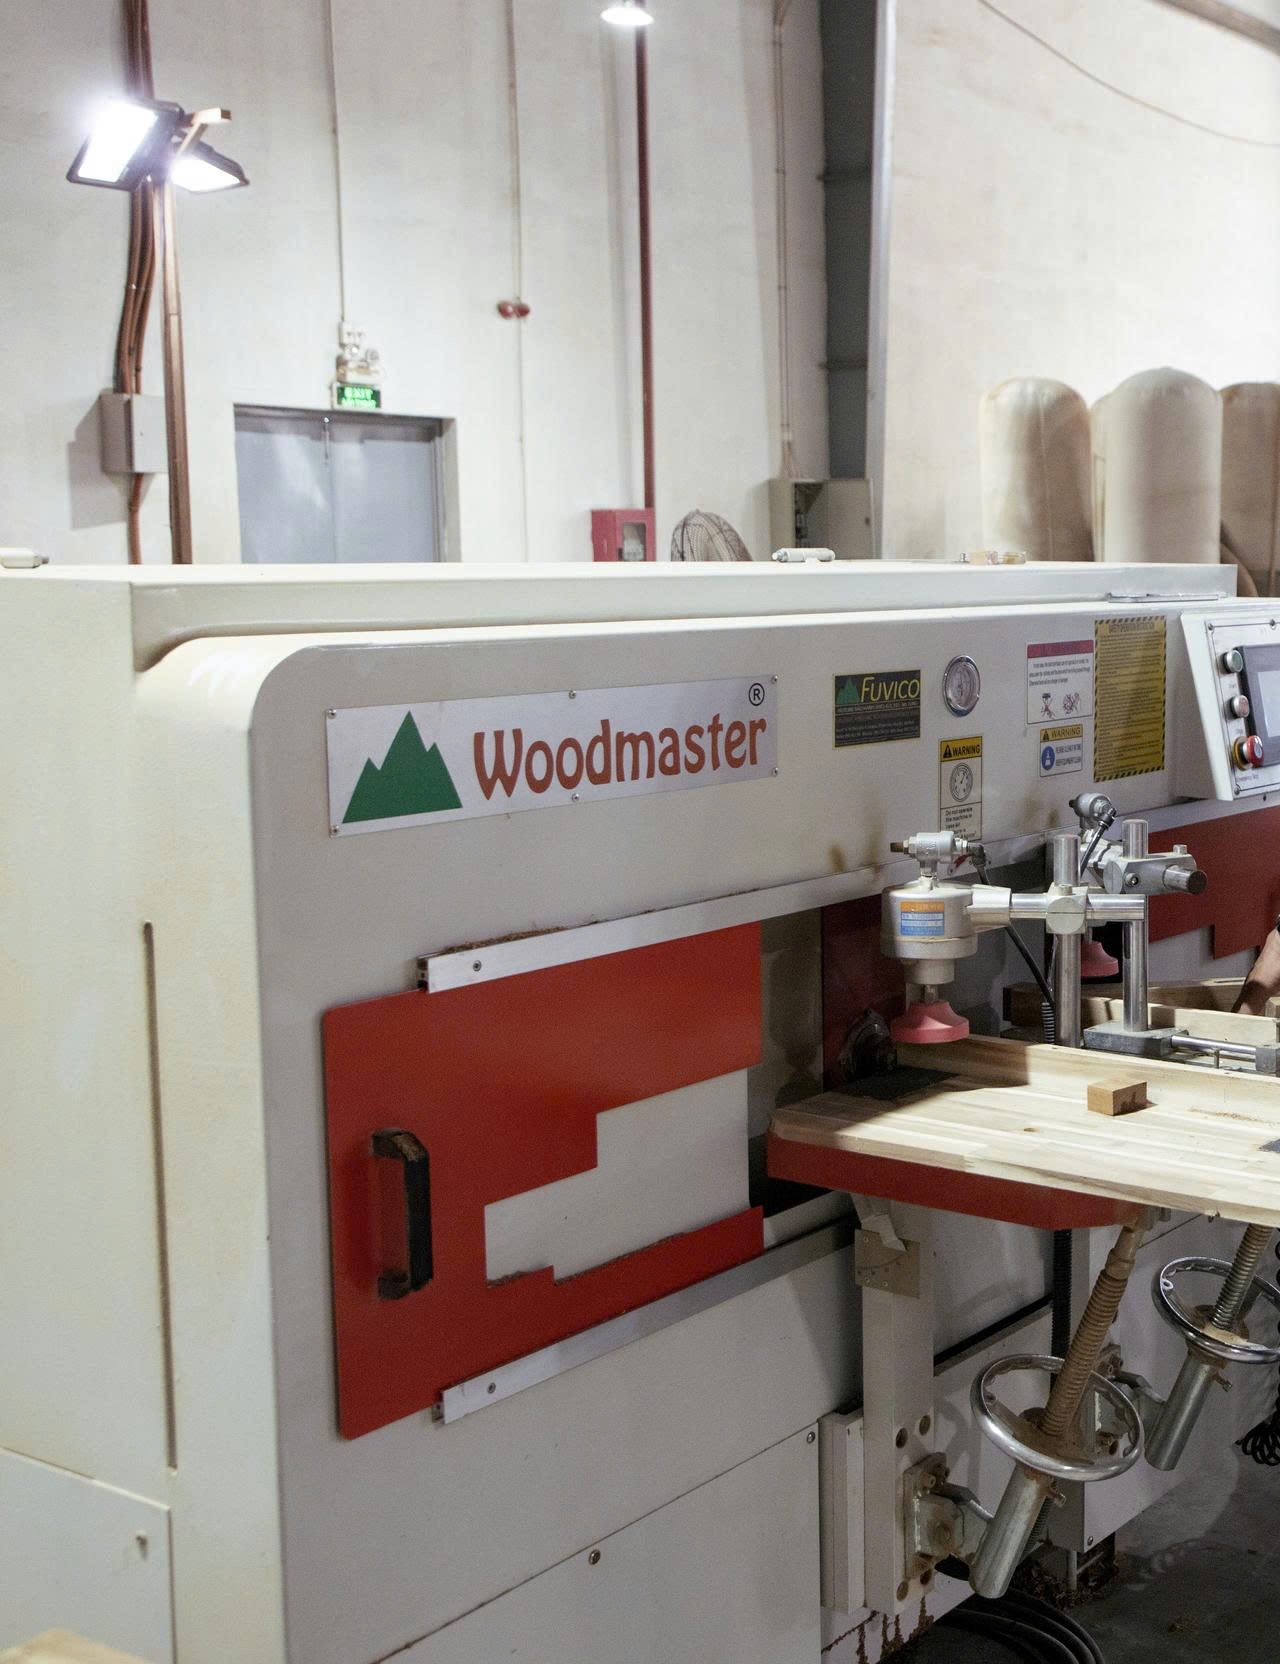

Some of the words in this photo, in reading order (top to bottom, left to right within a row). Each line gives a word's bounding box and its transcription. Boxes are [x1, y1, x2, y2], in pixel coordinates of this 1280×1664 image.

[861, 677, 920, 703] FUVICO
[1052, 727, 1081, 738] WARNING
[473, 713, 767, 801] Woodmaster
[952, 745, 980, 757] WARNING
